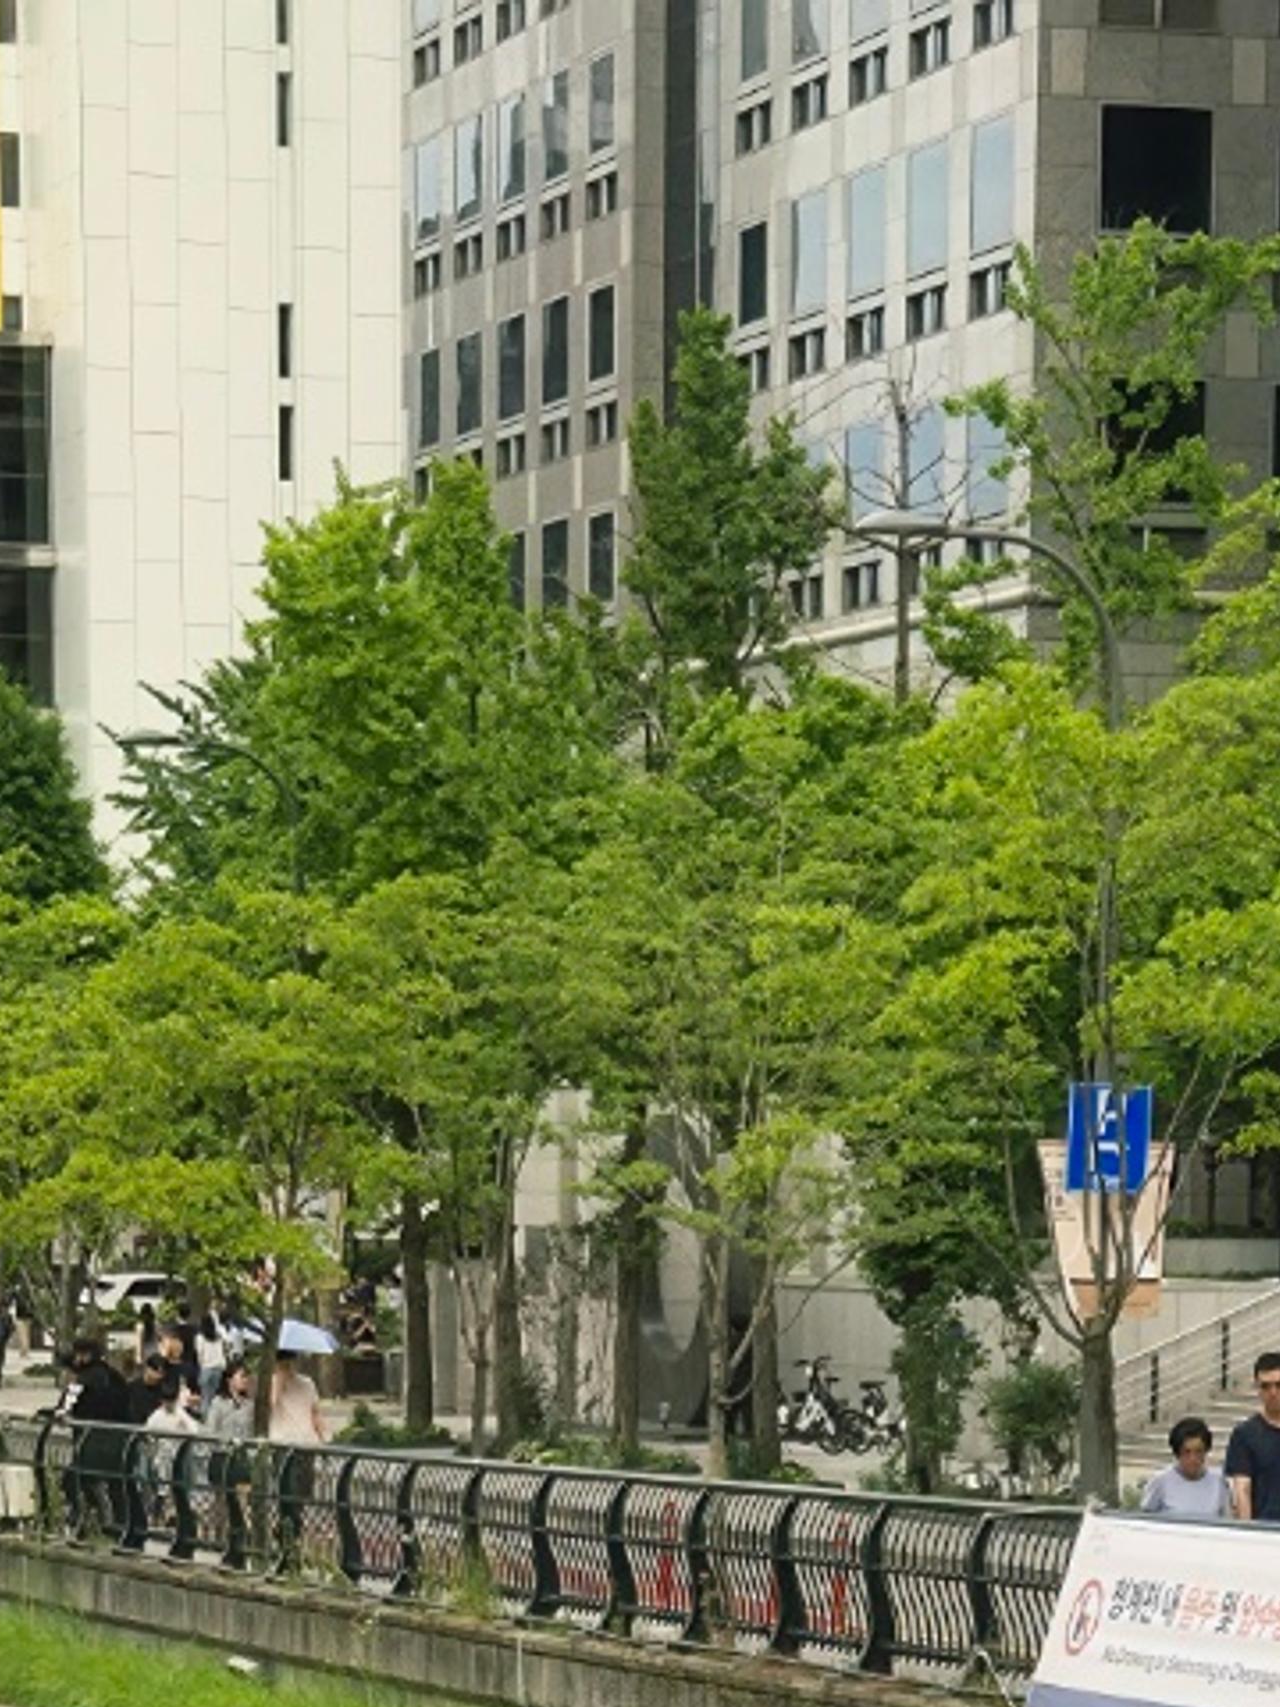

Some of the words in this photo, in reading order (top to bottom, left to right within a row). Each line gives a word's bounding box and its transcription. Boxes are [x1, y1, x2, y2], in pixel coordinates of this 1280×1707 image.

[1108, 1577, 1165, 1624] 청계천
[1160, 1582, 1184, 1627] 내
[1177, 1585, 1219, 1630] 음주
[1214, 1590, 1242, 1634] 및
